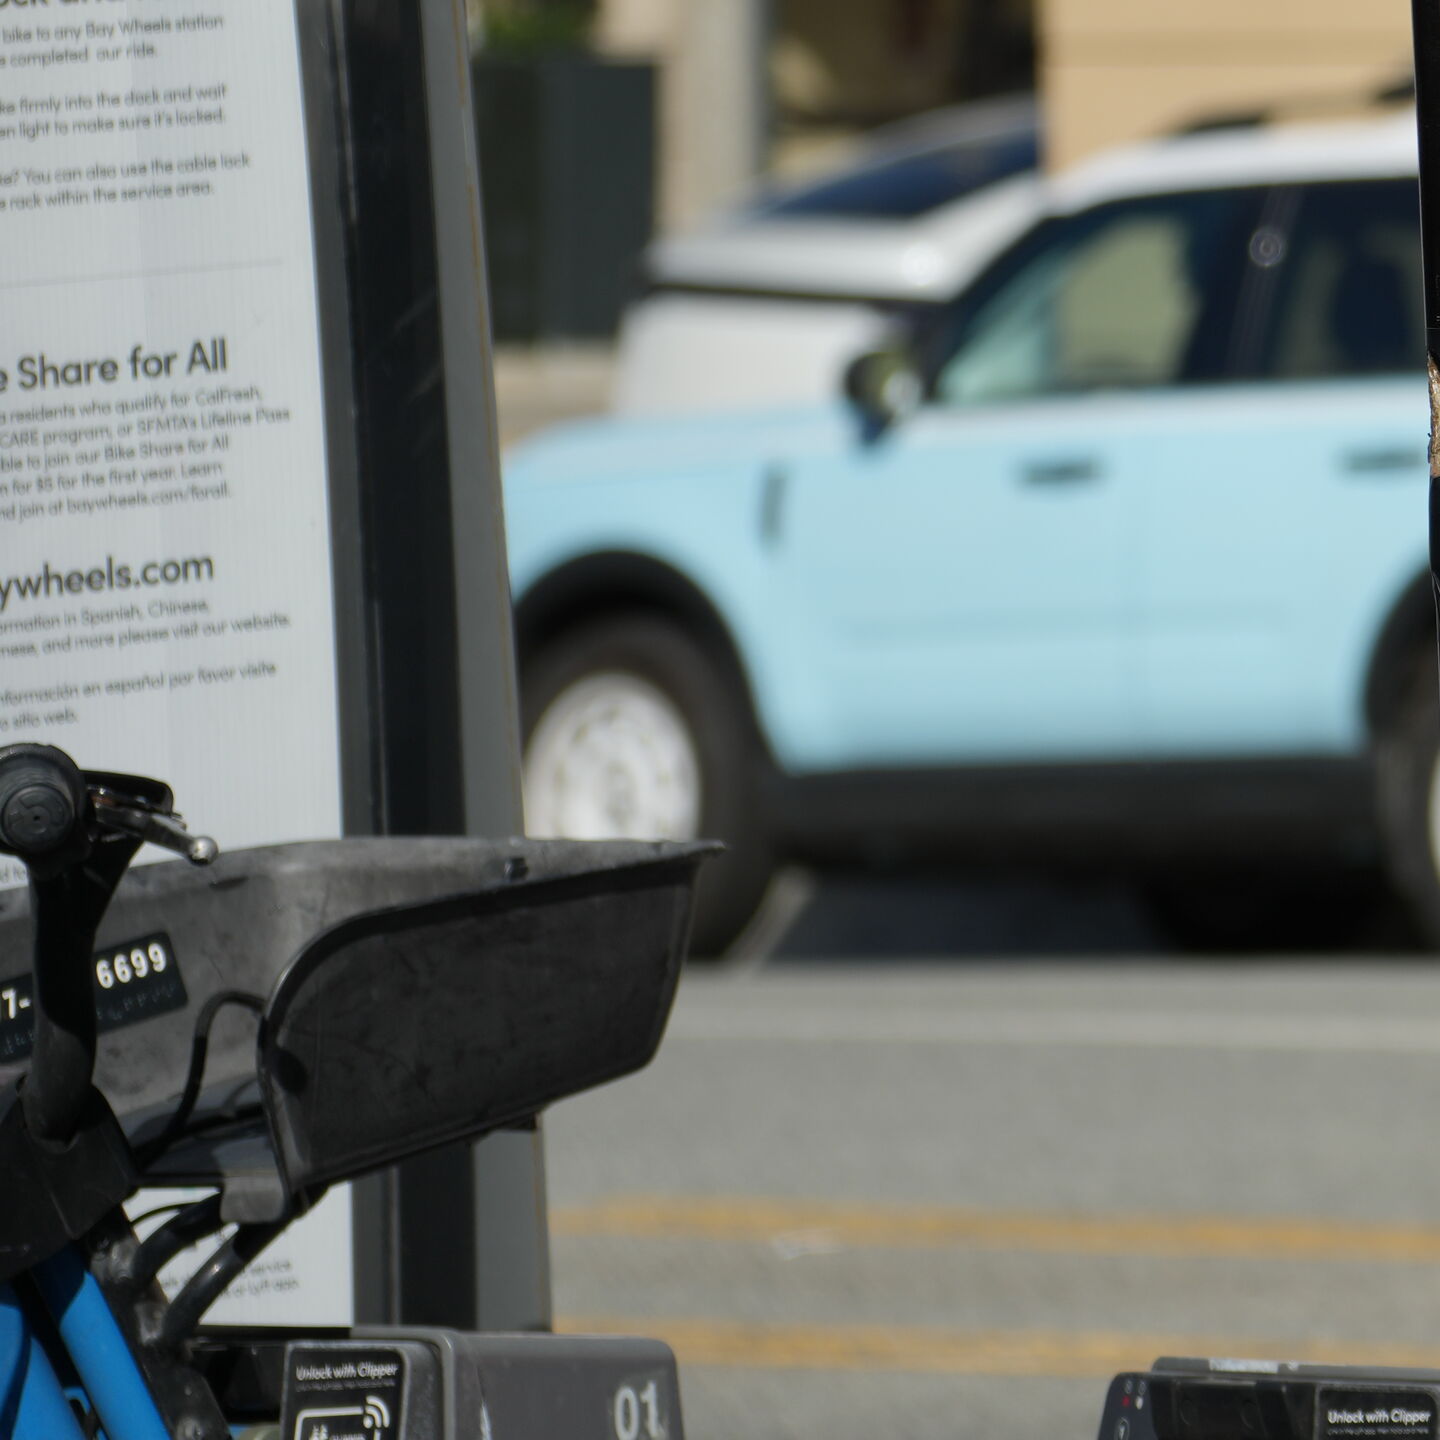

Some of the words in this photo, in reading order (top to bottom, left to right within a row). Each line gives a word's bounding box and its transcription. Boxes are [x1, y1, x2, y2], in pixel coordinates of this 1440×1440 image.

[2, 24, 32, 43] bike
[36, 25, 51, 42] to
[54, 25, 82, 43] any
[85, 19, 115, 37] Bay
[118, 16, 172, 35] Wheels
[175, 14, 224, 32] station
[10, 46, 89, 70] completed
[19, 94, 61, 115] firmly
[65, 93, 94, 111] into
[97, 91, 121, 109] the
[124, 87, 160, 105] dock
[163, 85, 193, 102] and
[195, 81, 228, 100] wait
[19, 121, 51, 143] light
[54, 120, 69, 137] to
[72, 115, 115, 135] make
[118, 113, 151, 130] sure
[22, 168, 51, 185] You
[54, 166, 83, 184] can
[86, 162, 117, 181] also
[120, 161, 148, 178] use
[151, 156, 174, 175] the
[177, 152, 217, 172] cable
[220, 150, 251, 170] lock
[9, 191, 42, 210] rack
[45, 187, 89, 209] within
[93, 185, 117, 204] the
[120, 182, 174, 203] service
[17, 350, 119, 392] Share
[127, 345, 178, 381] for
[186, 336, 228, 375] All
[9, 404, 76, 424] residents
[79, 399, 112, 418] who
[115, 394, 167, 416] qualify
[170, 391, 190, 409] for
[117, 423, 132, 438] or
[27, 453, 42, 471] to
[44, 452, 71, 473] join
[75, 451, 102, 466] our
[104, 443, 136, 462] Bike
[139, 439, 184, 458] Share
[187, 437, 209, 454] for
[211, 434, 229, 451] All
[12, 478, 33, 497] for
[57, 473, 78, 492] for
[81, 469, 105, 488] the
[109, 466, 137, 484] first
[19, 503, 45, 524] join
[48, 500, 64, 518] at
[42, 638, 72, 656] and
[295, 1364, 332, 1381] Unlock
[333, 1362, 357, 1379] with
[357, 1360, 398, 1380] Clipper
[614, 1380, 658, 1440] 01
[1327, 1409, 1364, 1425] Unlock
[1365, 1409, 1390, 1424] with
[1390, 1408, 1431, 1426] Clipper
